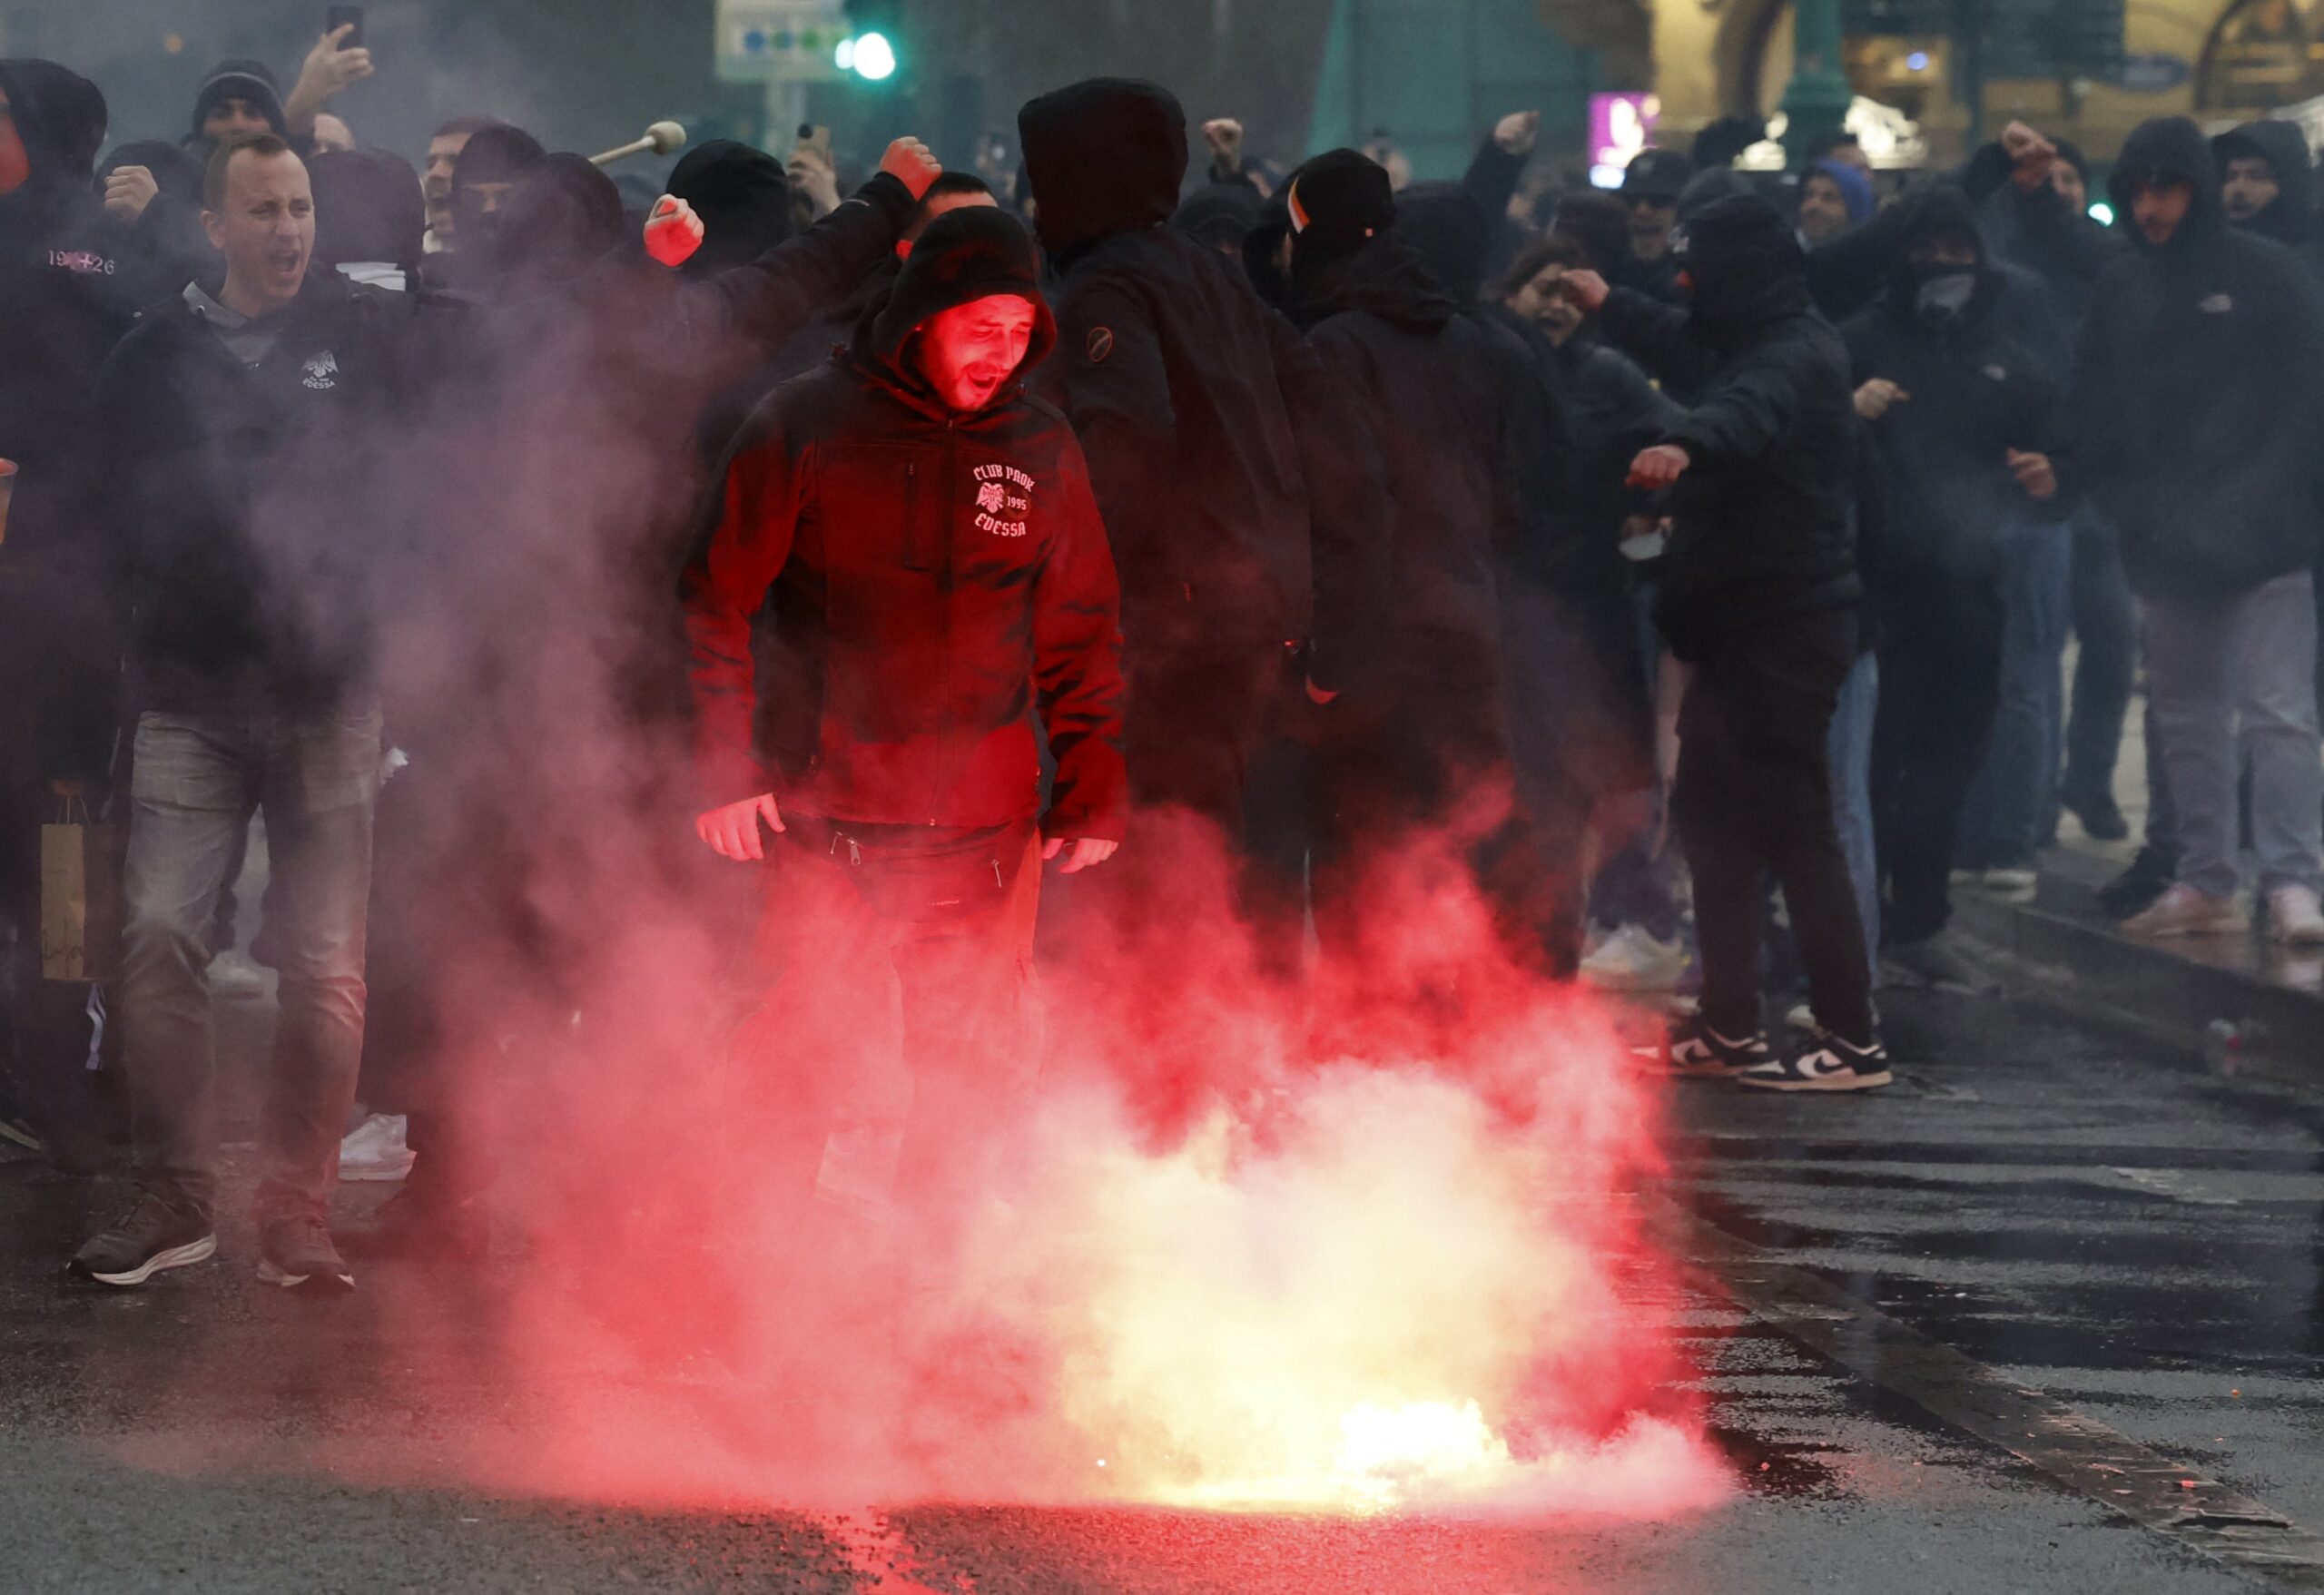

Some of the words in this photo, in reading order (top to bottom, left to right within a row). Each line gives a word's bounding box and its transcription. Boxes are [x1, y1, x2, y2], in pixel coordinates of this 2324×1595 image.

[973, 464, 1003, 481] CLUB
[1005, 466, 1036, 492] PAOK
[1007, 496, 1027, 510] 1995
[974, 513, 1026, 537] EDESSA
